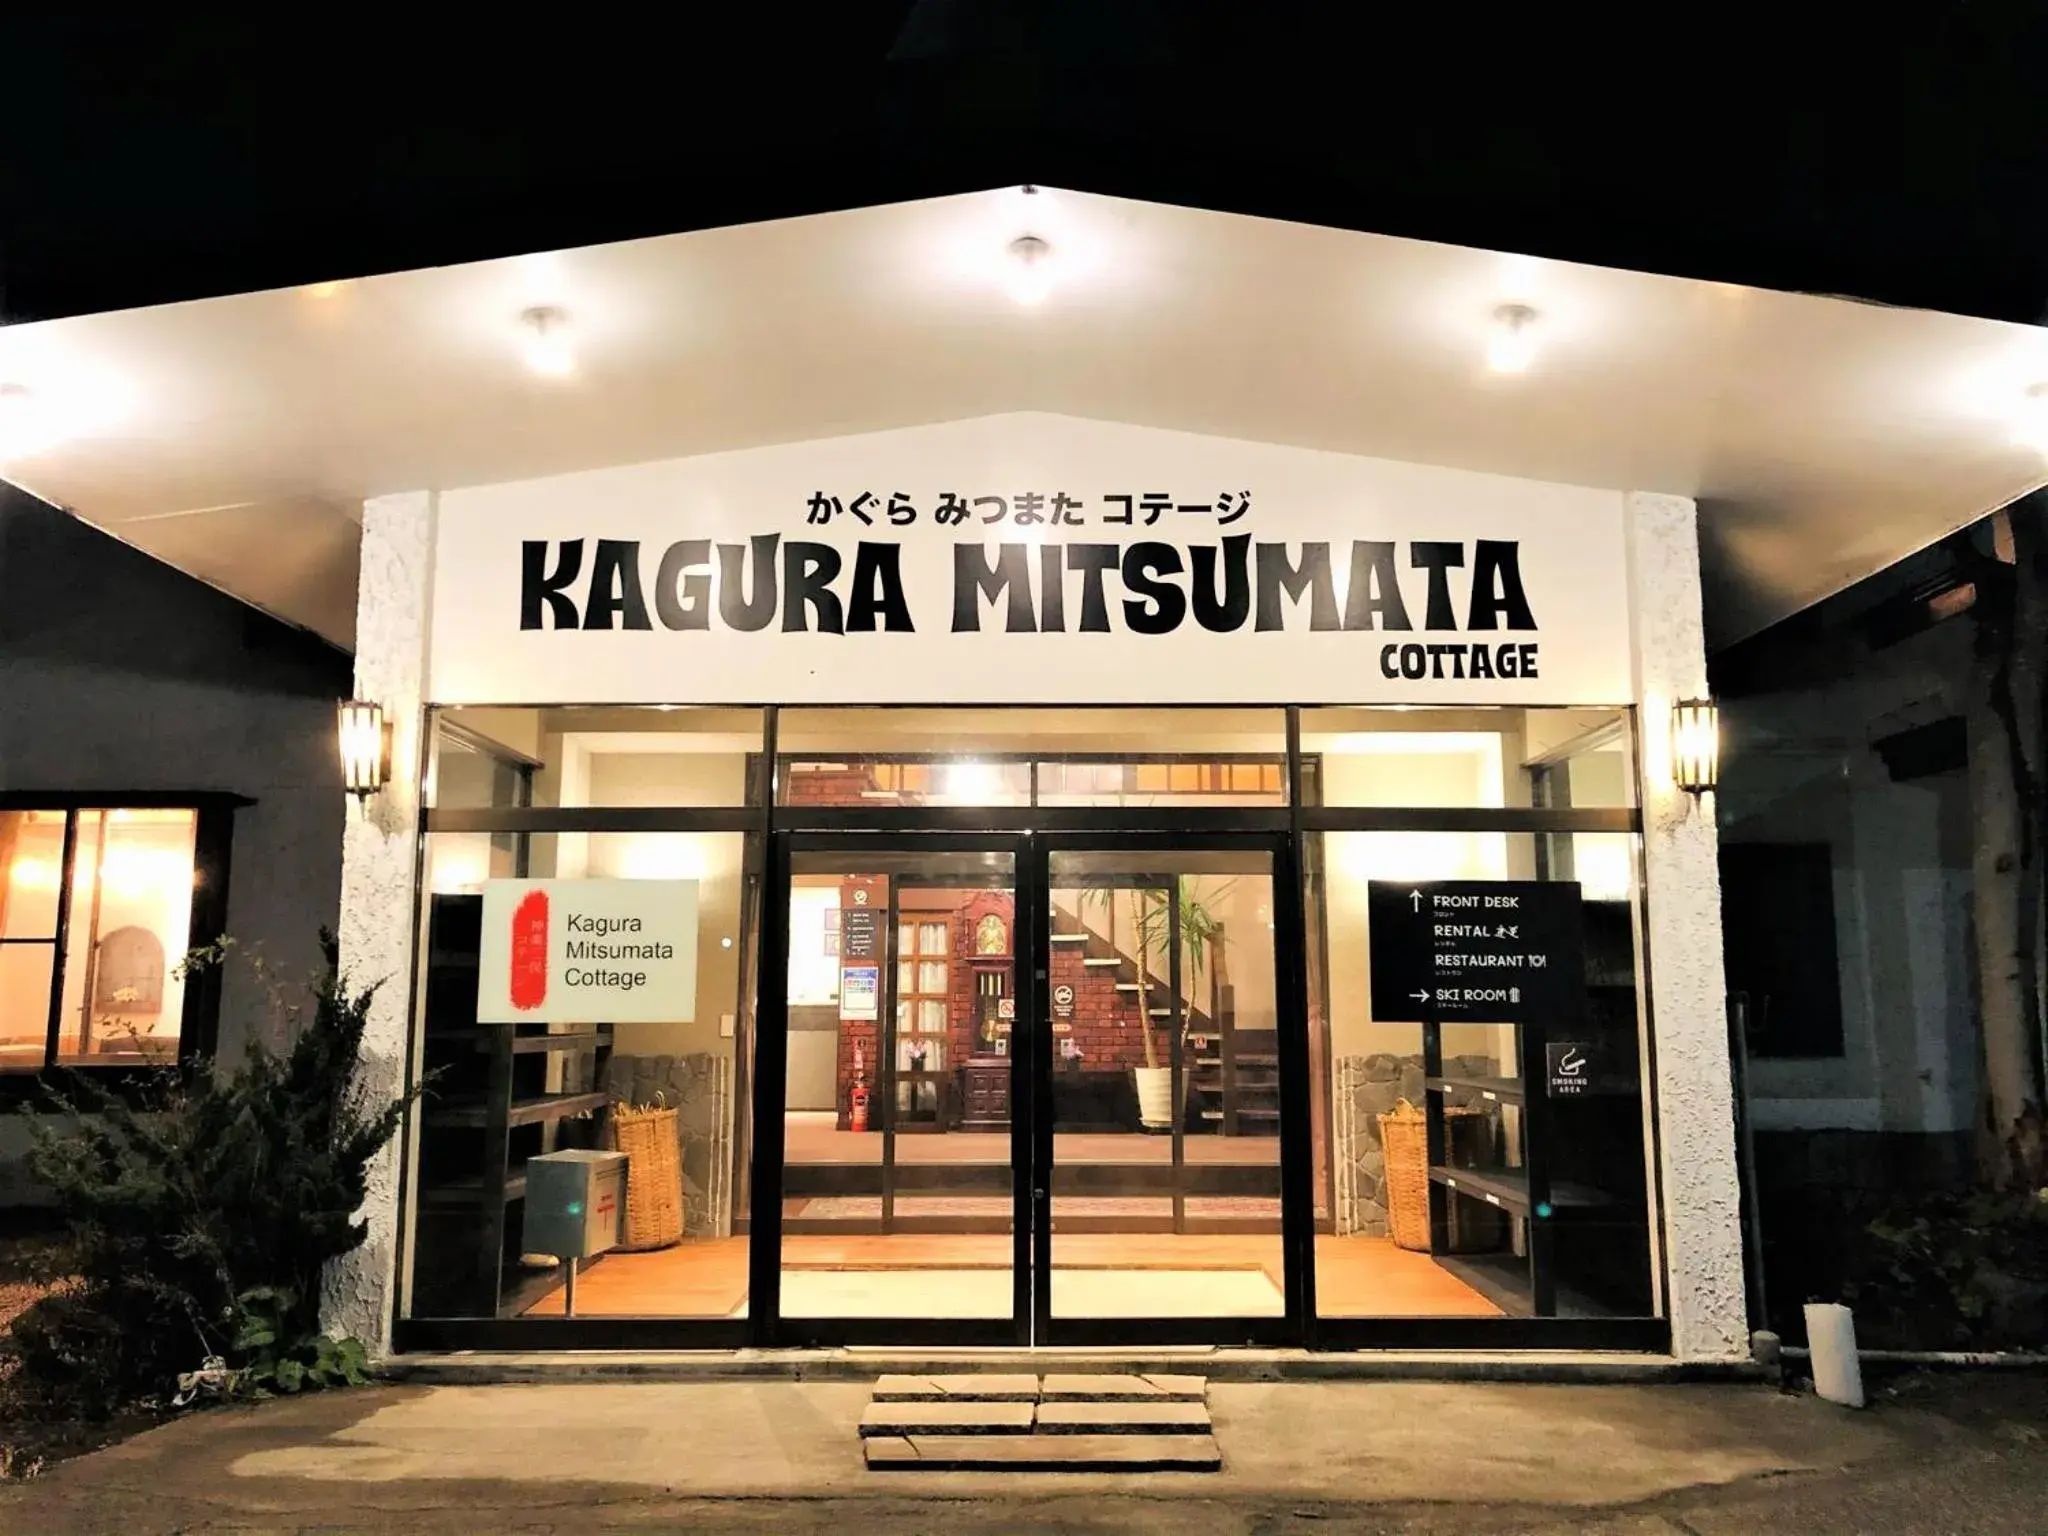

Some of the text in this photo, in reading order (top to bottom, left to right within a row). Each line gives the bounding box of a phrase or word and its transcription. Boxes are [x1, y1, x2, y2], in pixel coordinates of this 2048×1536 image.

[807, 490, 1251, 526] かぐら みつまた コテージ
[520, 532, 1539, 636] KAGURA MITSUMATA
[1380, 643, 1539, 679] COTTAGE
[1433, 895, 1519, 908] FRONT DESK
[567, 914, 642, 937] Kagura
[1434, 925, 1490, 938] RENTAL
[566, 941, 673, 960] Mitsumata
[1434, 954, 1524, 967] RESTAURANT
[564, 967, 647, 990] Cottage
[1435, 989, 1507, 1001] SKI ROOM
[1551, 1078, 1588, 1086] SMOKING
